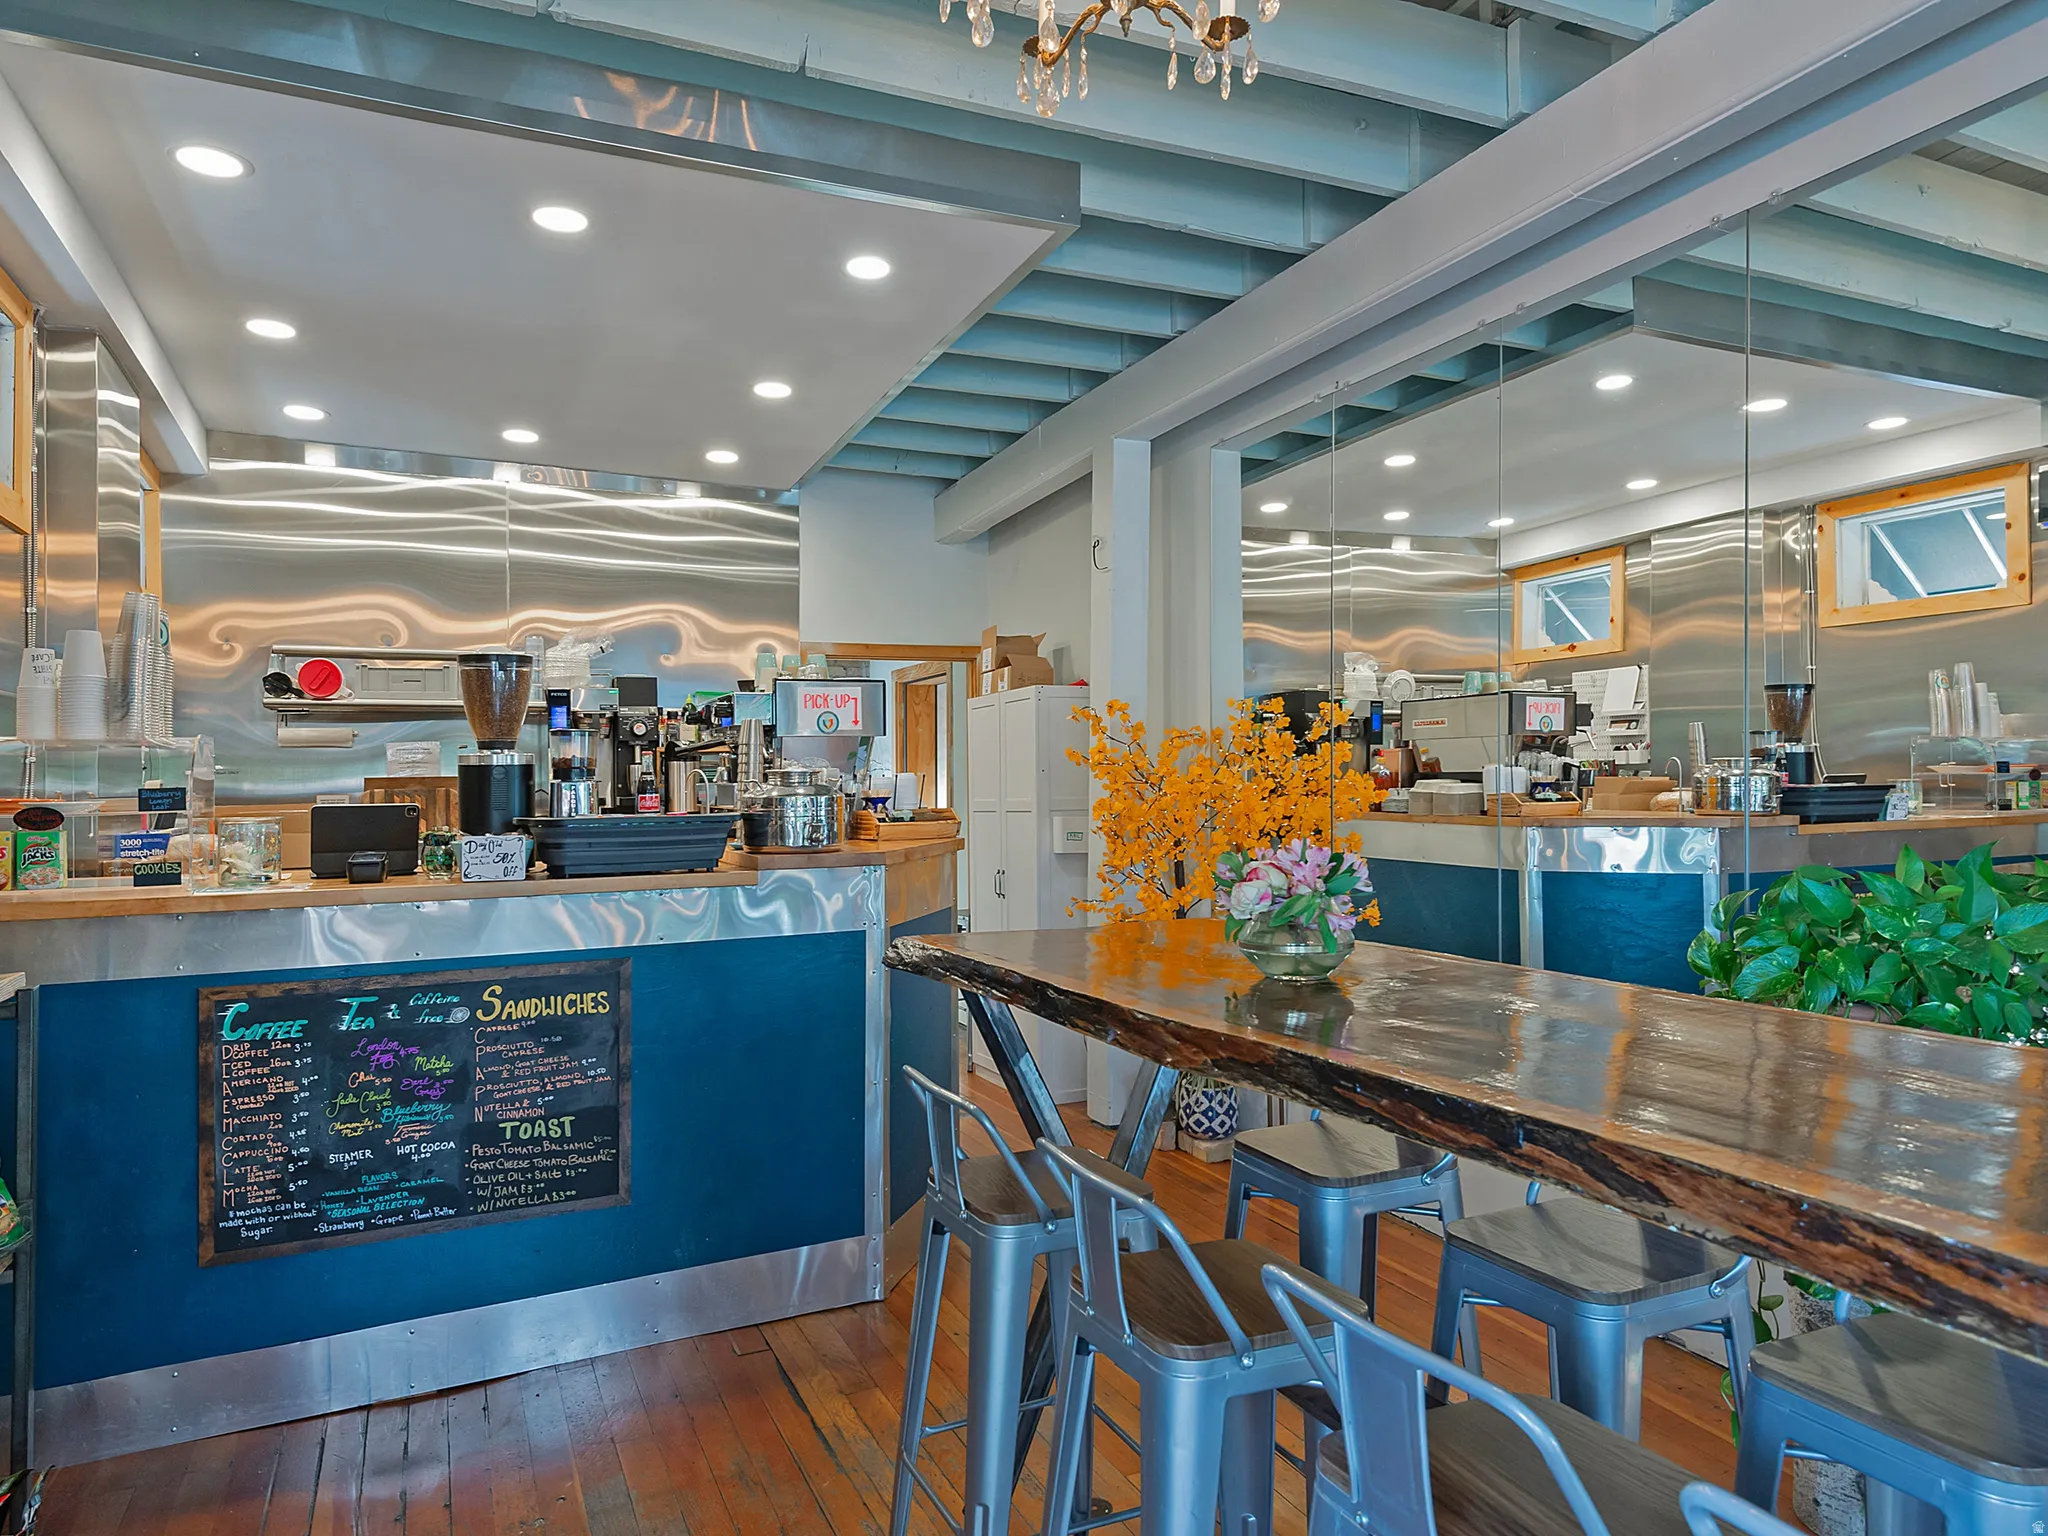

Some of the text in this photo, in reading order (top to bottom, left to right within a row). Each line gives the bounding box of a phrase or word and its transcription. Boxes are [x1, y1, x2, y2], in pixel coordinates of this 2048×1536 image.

[803, 693, 851, 709] PICK-UP
[120, 838, 142, 846] 3000
[22, 852, 55, 867] JACKS
[120, 848, 165, 857] stretch-tite
[492, 852, 516, 864] 50%
[134, 863, 181, 875] COOKIES
[337, 996, 379, 1031] TEA
[408, 992, 460, 1006] Caffeine
[476, 985, 610, 1022] SANDWICHES
[221, 1002, 308, 1040] COFFEE
[474, 1023, 520, 1044] CAPRESE
[222, 1042, 250, 1060] DRIP
[232, 1049, 269, 1059] COFFEE
[351, 1038, 400, 1057] London
[476, 1041, 534, 1062] PROSCIUTTO
[502, 1047, 545, 1058] CAPRESE
[222, 1061, 252, 1078] ICED
[414, 1055, 454, 1072] Matcha
[514, 1068, 532, 1076] RED
[534, 1064, 558, 1074] FRUIT
[559, 1060, 579, 1070] JAM
[515, 1060, 536, 1068] GOAT
[538, 1055, 570, 1064] CHEESE
[232, 1066, 270, 1077] COFFEE
[588, 1068, 606, 1076] 10.50
[223, 1076, 284, 1096] AMERICANO
[348, 1072, 376, 1088] Chai
[326, 1088, 392, 1118] Jade Cloud
[493, 1090, 513, 1100] GOAT
[223, 1094, 275, 1114] ESPRESSO
[380, 1101, 452, 1123] Blueberry
[474, 1102, 520, 1122] NUTELLA
[496, 1107, 545, 1120] CINNAMON
[223, 1112, 282, 1132] MACCHIATO
[498, 1116, 576, 1140] TOAST
[222, 1133, 274, 1150] CORTADO
[396, 1141, 456, 1156] HOT COCOA
[472, 1144, 500, 1156] PESTO
[500, 1142, 542, 1154] TOMATO
[542, 1140, 596, 1152] BALSAMIC
[222, 1146, 288, 1166] CAPPUCCINO
[329, 1149, 374, 1164] STEAMER
[470, 1159, 496, 1171] GOAT
[496, 1158, 530, 1169] CHEESE
[532, 1157, 568, 1168] TOMATO
[568, 1154, 614, 1166] BALSAMIC
[224, 1164, 260, 1186] LATTE
[362, 1172, 398, 1184] FLAVORS
[400, 1177, 444, 1188] CARAMEL
[473, 1174, 504, 1185] OLIVE
[508, 1172, 524, 1180] OIL
[223, 1185, 259, 1208] MOCHA
[324, 1185, 380, 1197] VANILLA BEAN
[360, 1192, 410, 1204] LAVENDER
[494, 1186, 518, 1198] JAM
[274, 1203, 292, 1211] can
[294, 1201, 306, 1209] be
[331, 1198, 426, 1218] SEASONAL SELECTION
[219, 1218, 244, 1228] made
[245, 1216, 266, 1226] with
[283, 1209, 318, 1220] without
[318, 1220, 364, 1233] Strawberry
[376, 1214, 404, 1226] Grape
